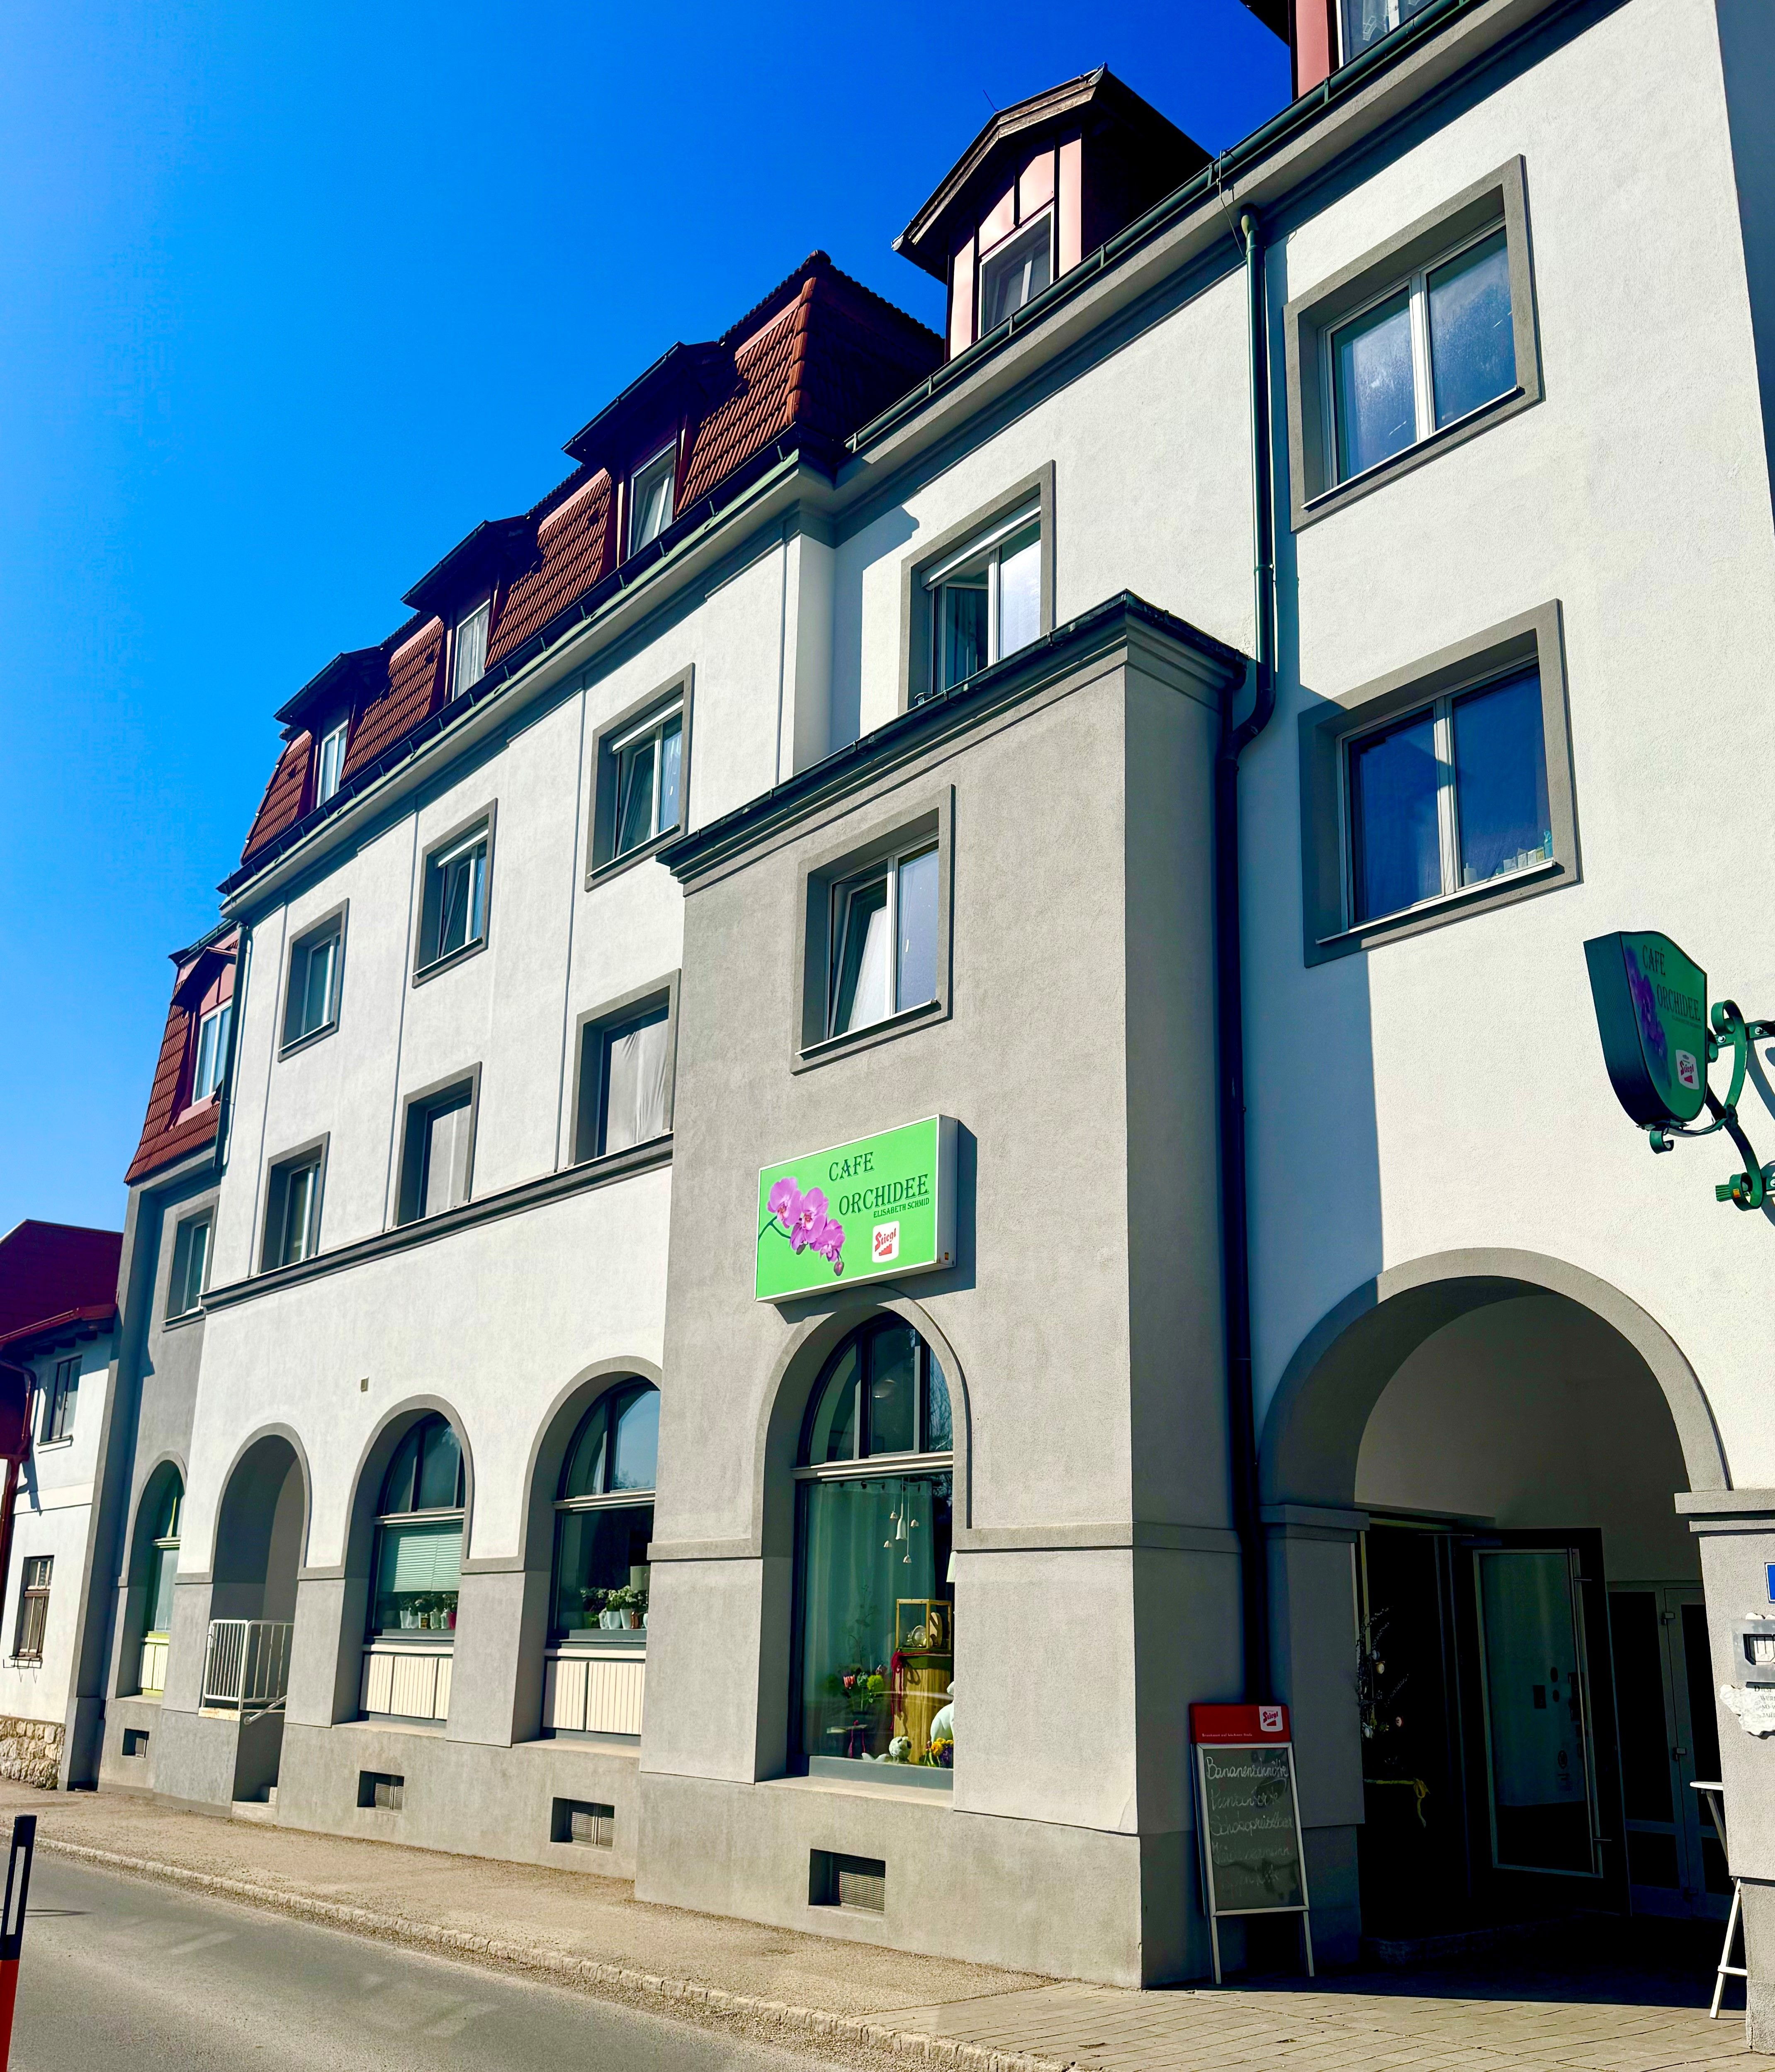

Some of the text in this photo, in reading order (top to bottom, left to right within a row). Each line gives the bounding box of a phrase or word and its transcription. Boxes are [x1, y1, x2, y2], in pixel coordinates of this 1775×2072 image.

[1656, 984, 1701, 1022] ORCHIDEE
[1680, 1060, 1694, 1076] Stiegl
[829, 1151, 875, 1182] CAFE
[839, 1173, 929, 1215] ORCHIDEE
[873, 1198, 930, 1218] ELISABETH SCHMID
[875, 1227, 896, 1252] Stiegl
[1262, 1711, 1278, 1723] Stiegl
